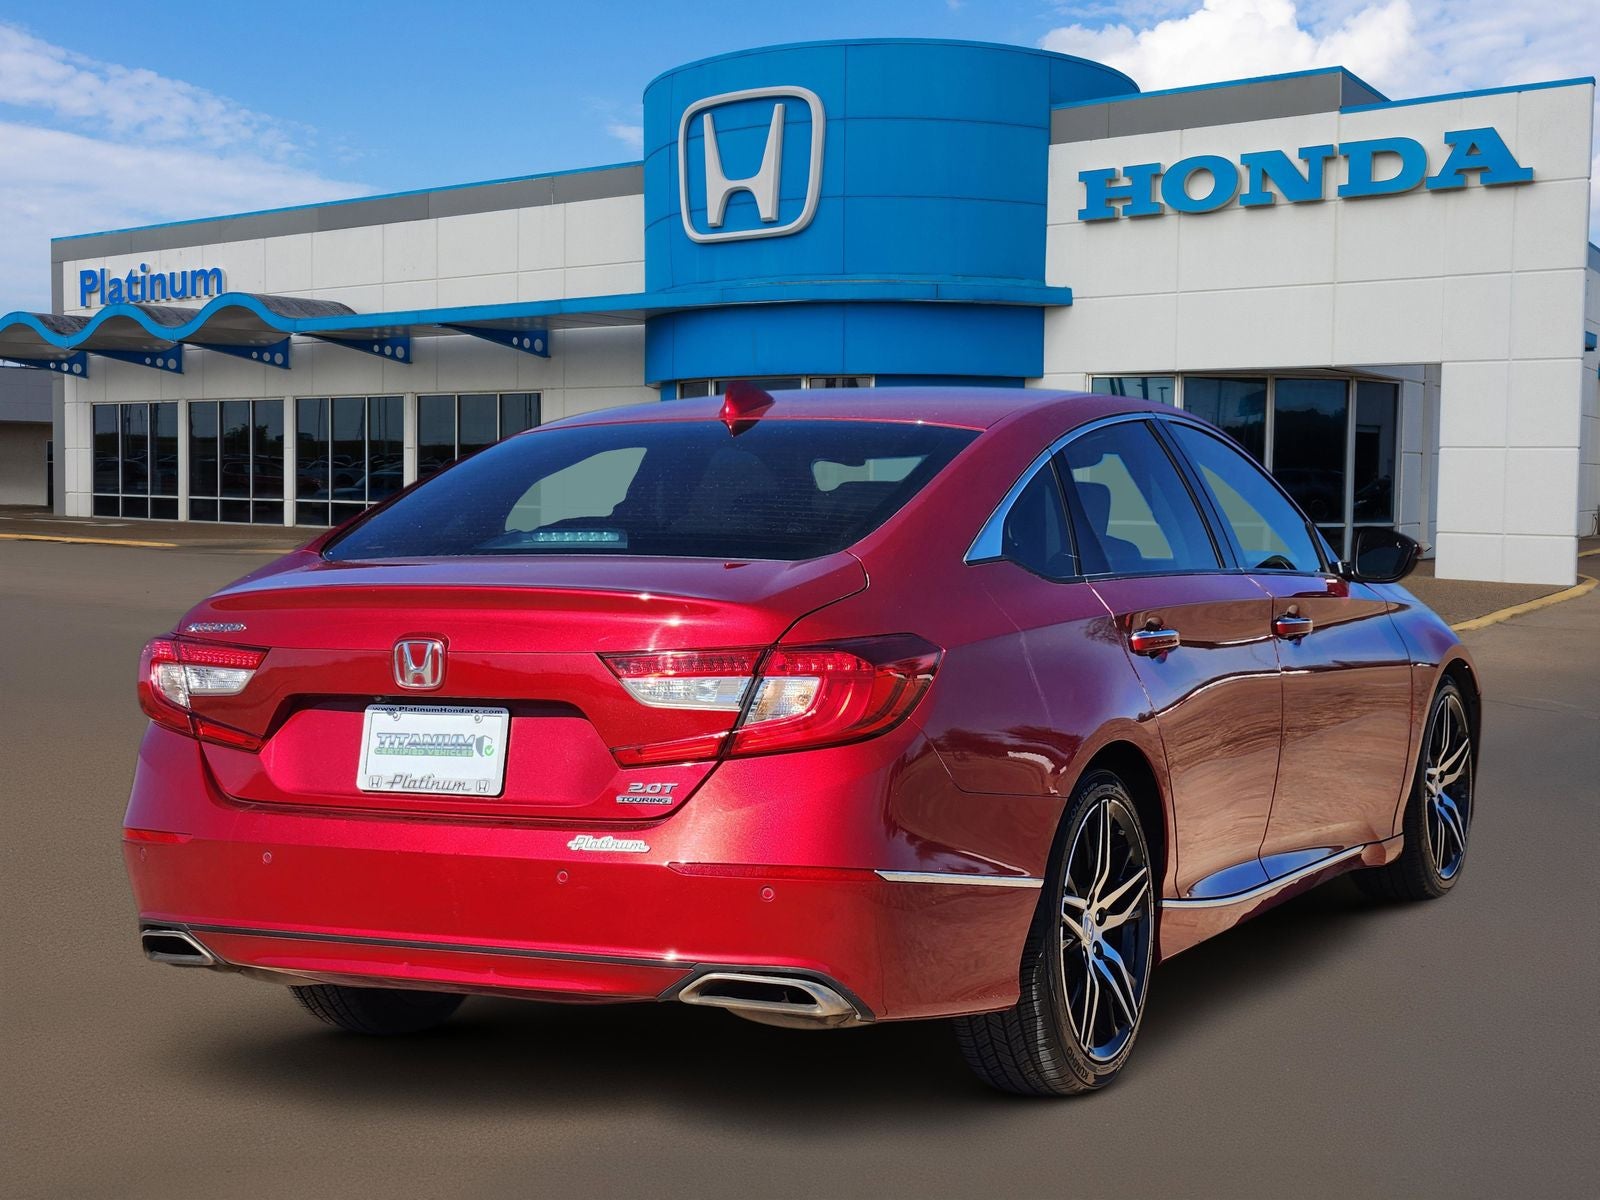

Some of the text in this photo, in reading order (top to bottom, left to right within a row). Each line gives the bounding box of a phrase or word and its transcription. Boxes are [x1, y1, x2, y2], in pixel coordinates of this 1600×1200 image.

[1077, 127, 1534, 221] HONDA
[80, 263, 224, 307] Platinum
[376, 732, 476, 750] TITANIUM
[385, 772, 472, 792] Platinum
[628, 782, 679, 794] 2.0T
[620, 796, 670, 804] TOURING
[568, 835, 651, 852] Platinum
